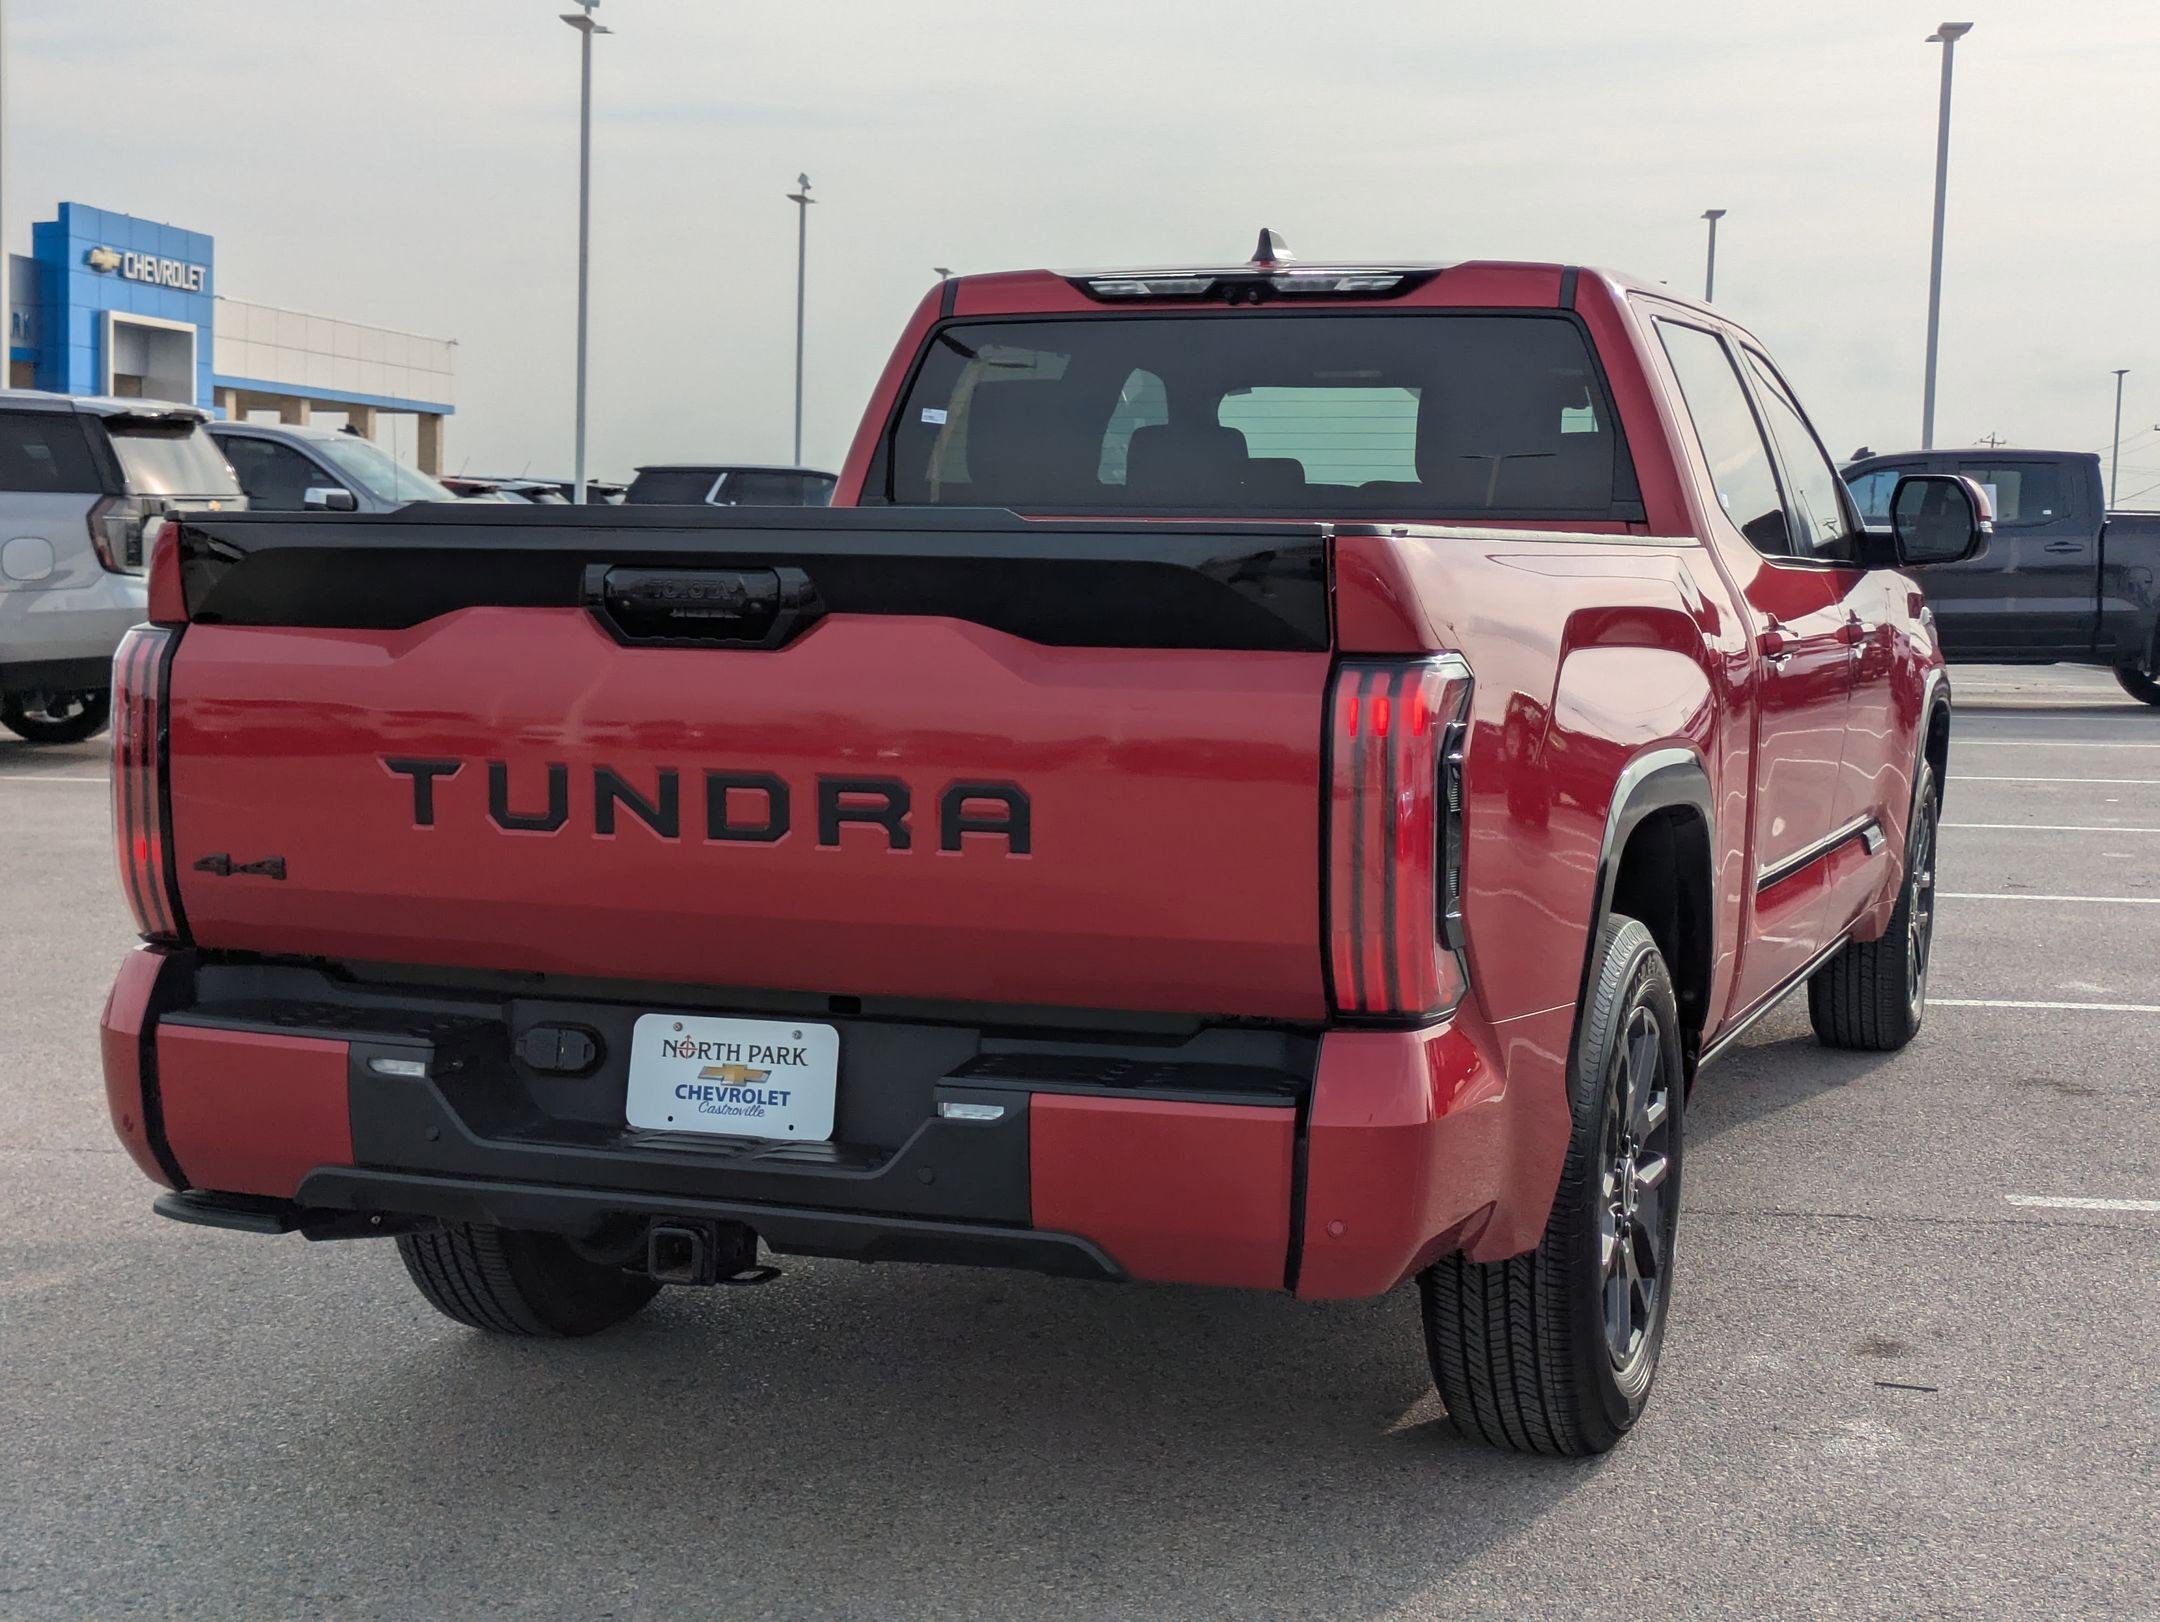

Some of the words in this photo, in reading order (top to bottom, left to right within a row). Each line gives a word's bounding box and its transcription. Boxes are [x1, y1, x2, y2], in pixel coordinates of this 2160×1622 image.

[123, 251, 206, 292] CHEVROLET
[378, 756, 1032, 856] TUNDRA
[661, 1037, 741, 1062] NORTH
[748, 1044, 808, 1066] PARK
[675, 1084, 791, 1107] CHEVROLET
[698, 1101, 766, 1118] Castroville
